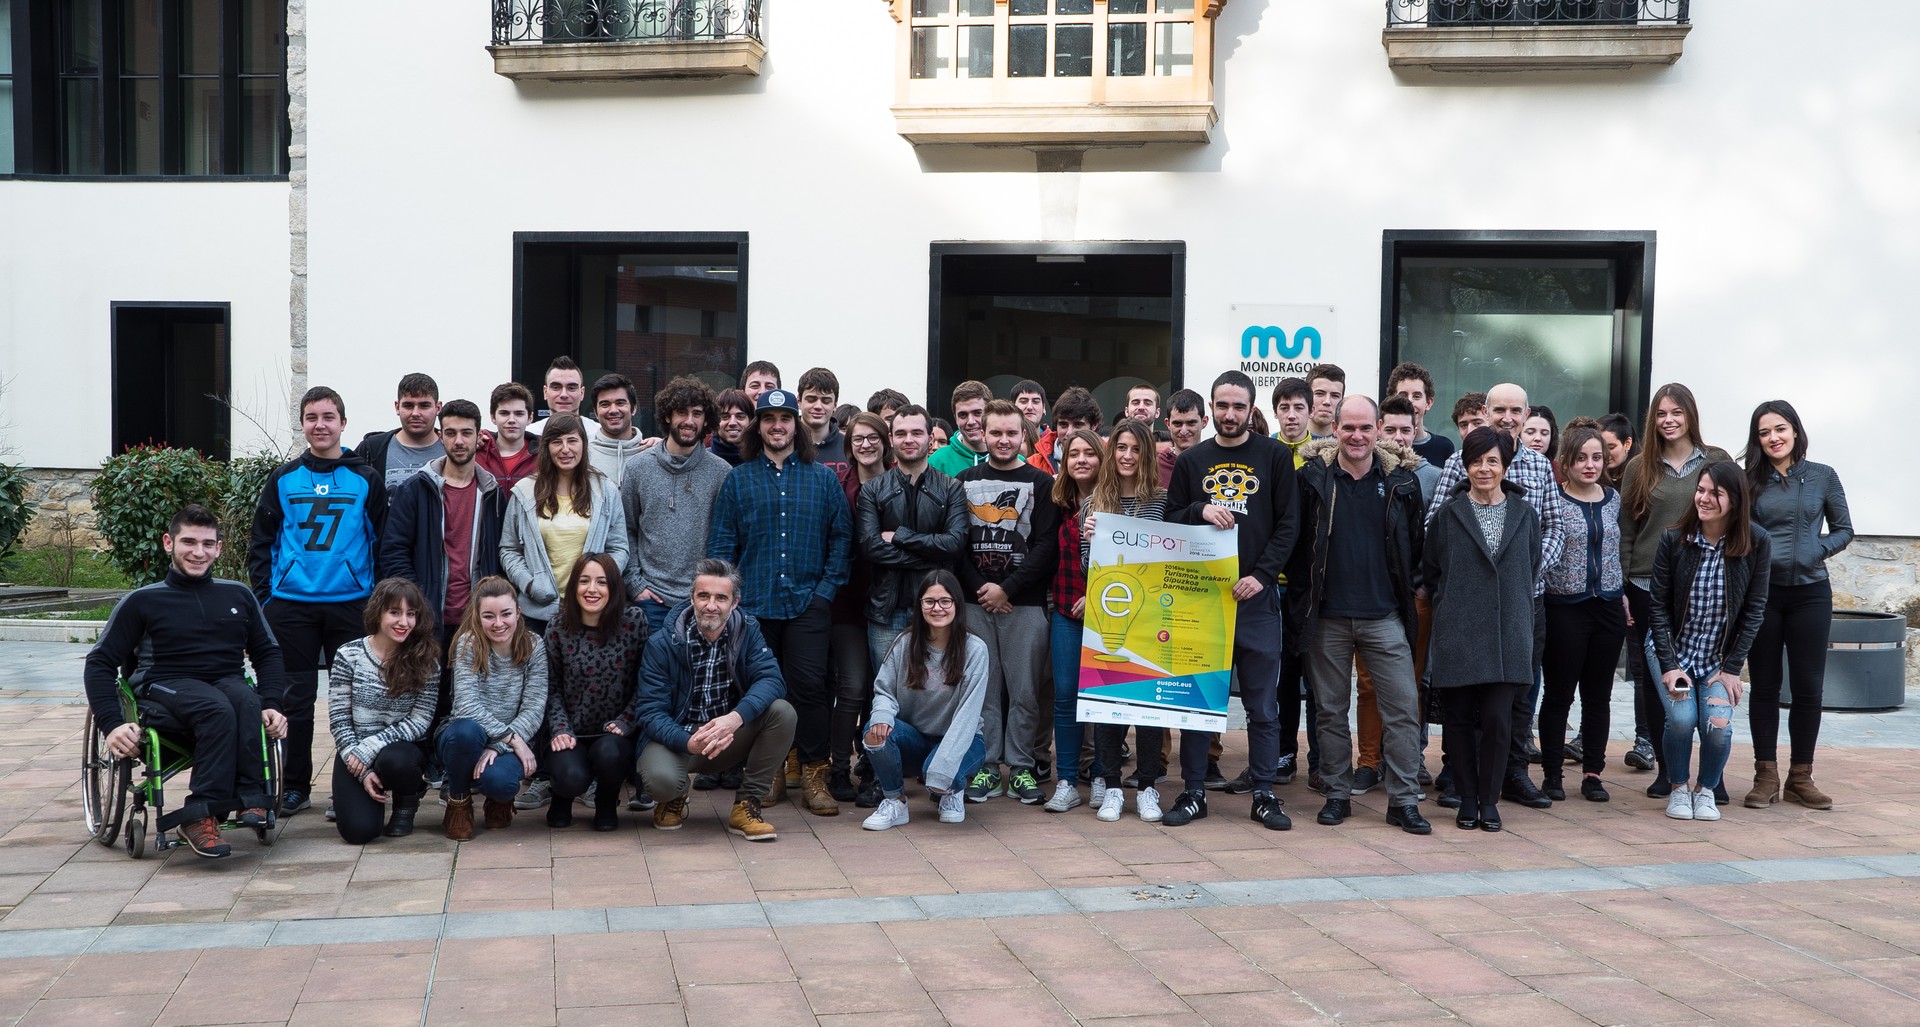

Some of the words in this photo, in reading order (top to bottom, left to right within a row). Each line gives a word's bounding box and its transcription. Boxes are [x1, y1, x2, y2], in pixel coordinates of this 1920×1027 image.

[1163, 576, 1199, 586] Gipuzkoa
[1164, 570, 1198, 580] Turismoa
[1200, 575, 1231, 583] erakarri
[1162, 583, 1209, 594] barnealdera
[1101, 582, 1133, 617] e
[1156, 680, 1192, 688] euspot.eus
